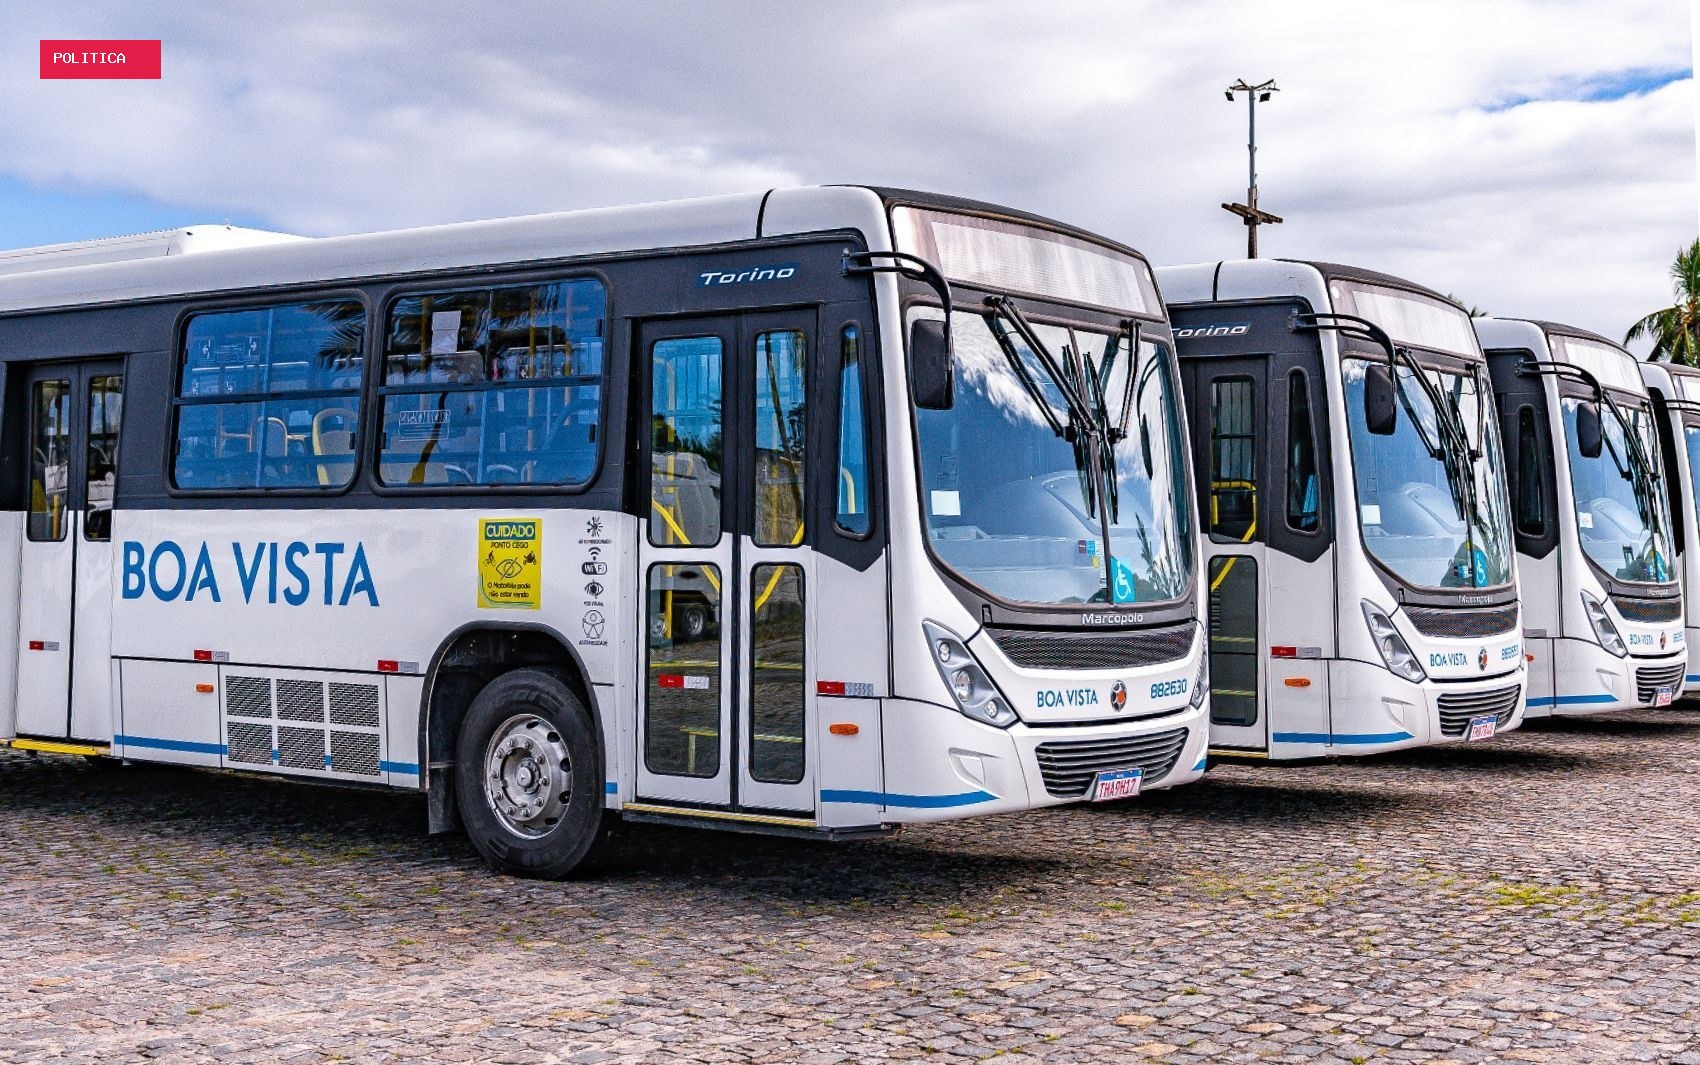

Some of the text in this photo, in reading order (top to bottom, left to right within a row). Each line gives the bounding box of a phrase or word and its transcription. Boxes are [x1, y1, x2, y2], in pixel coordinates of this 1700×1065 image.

[700, 267, 795, 285] Torino
[486, 524, 534, 537] CUIDADO
[490, 541, 510, 549] PONTO
[122, 540, 380, 607] BOA VISTA
[1082, 612, 1143, 626] Marcopolo
[1429, 653, 1468, 667] BOA VISTA
[1150, 677, 1188, 699] 882630
[1037, 688, 1098, 708] BOA VISTA
